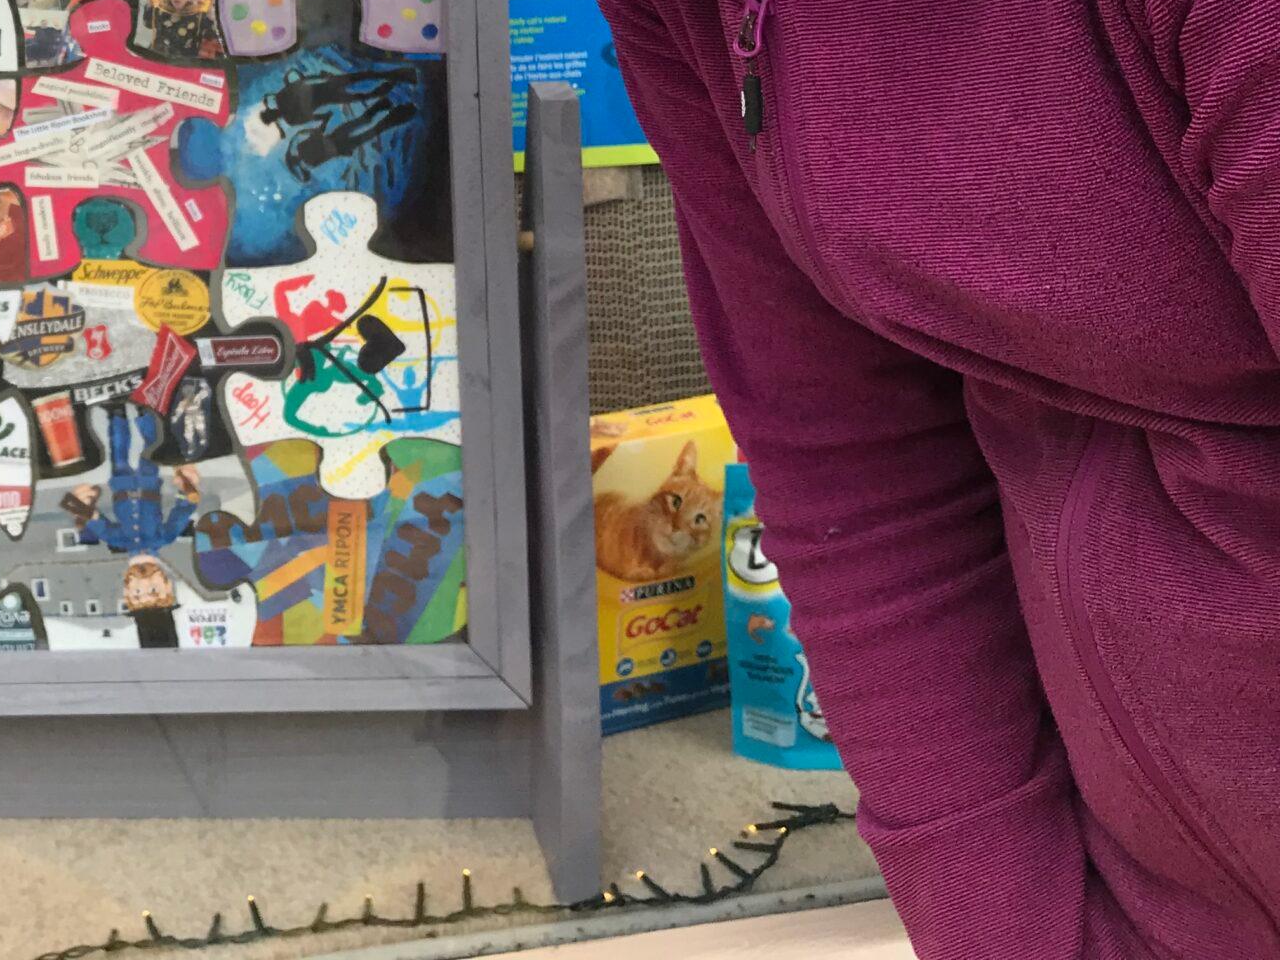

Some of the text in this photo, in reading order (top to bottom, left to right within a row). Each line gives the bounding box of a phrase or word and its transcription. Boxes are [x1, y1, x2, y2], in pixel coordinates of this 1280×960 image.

[94, 61, 217, 109] Beloved Friends
[331, 511, 352, 626] YMCA RIPON
